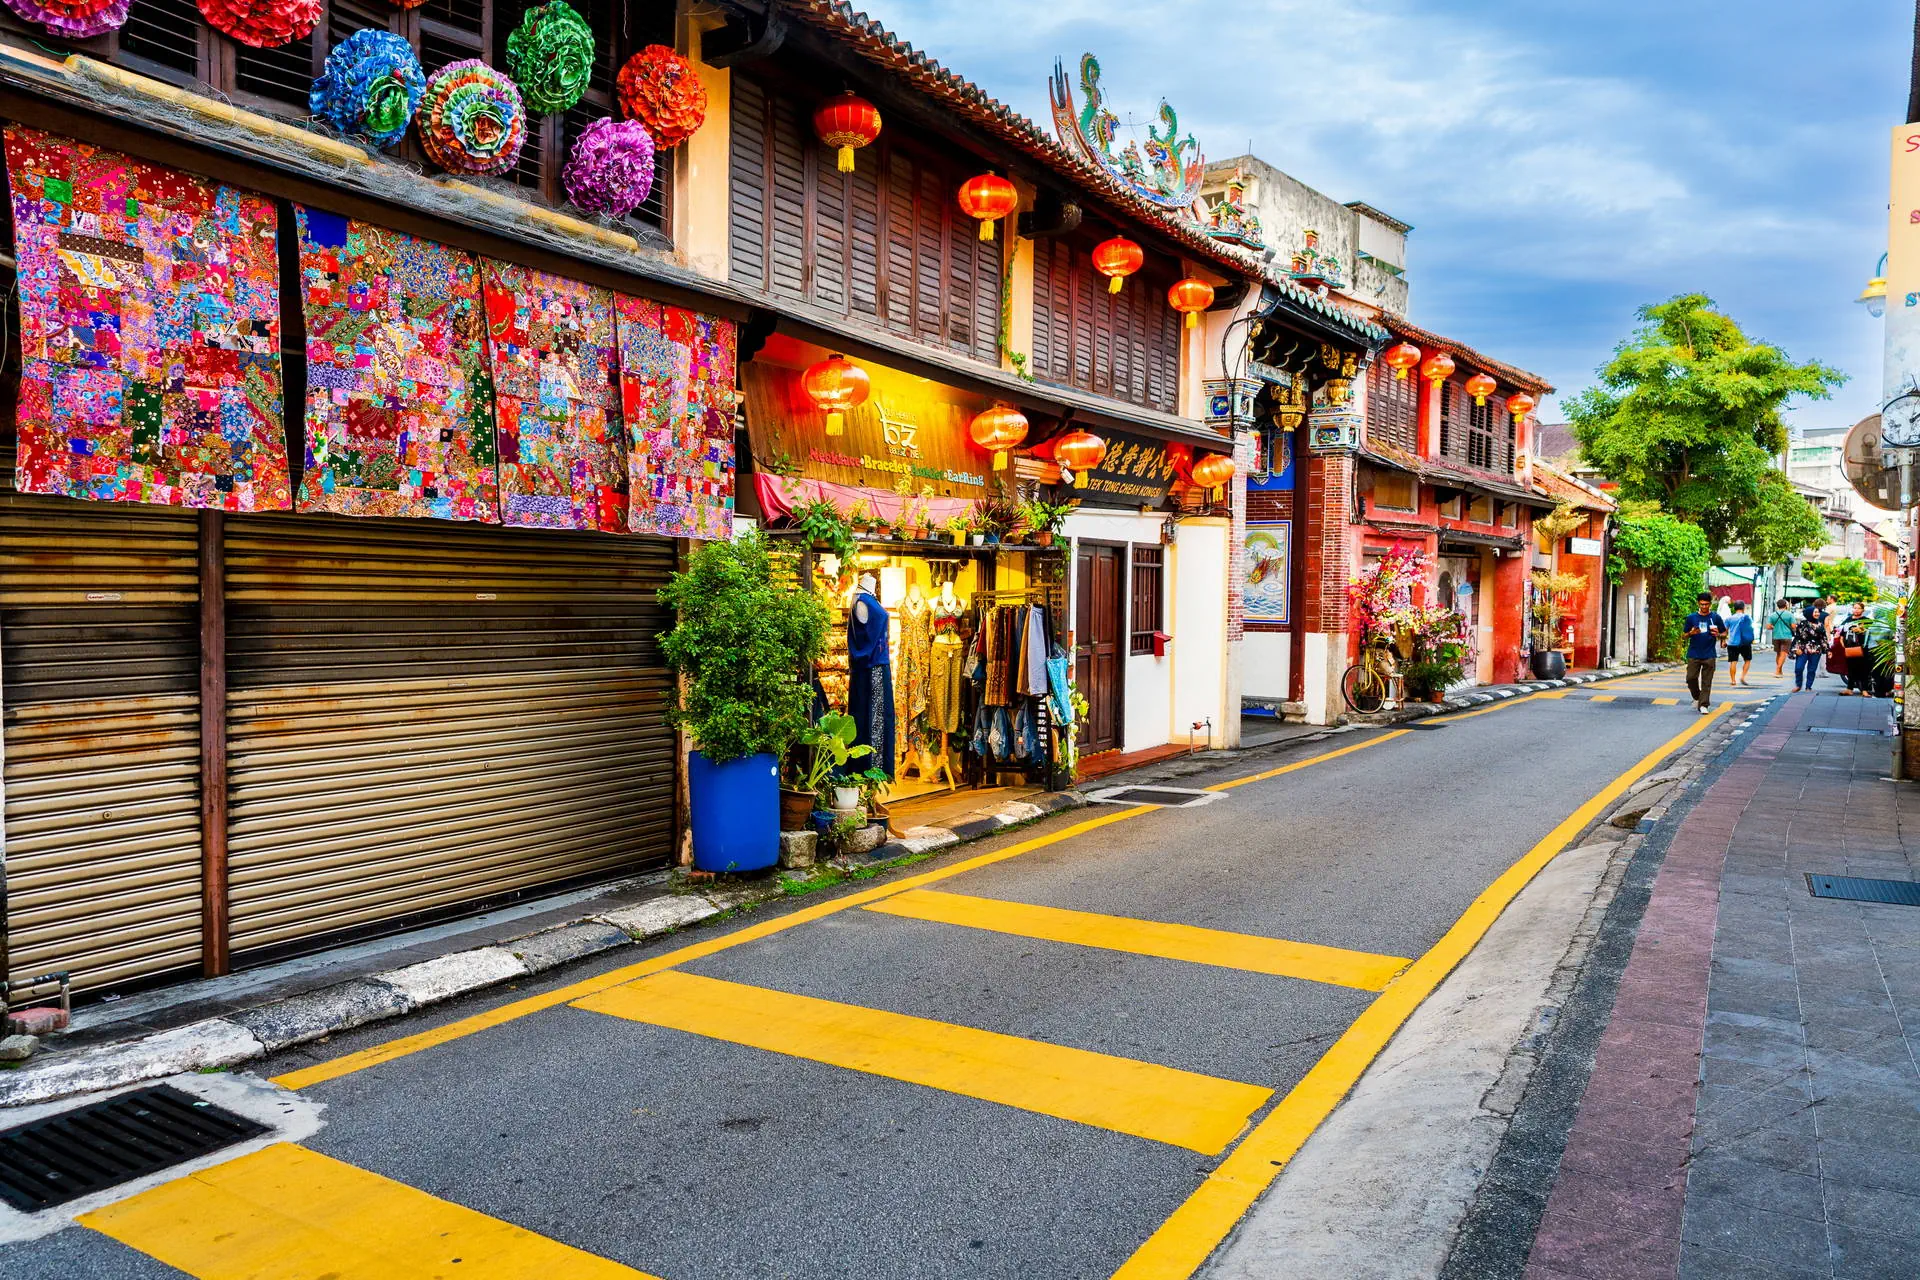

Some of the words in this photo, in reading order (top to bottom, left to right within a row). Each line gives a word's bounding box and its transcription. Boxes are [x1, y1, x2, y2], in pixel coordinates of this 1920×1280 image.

[809, 448, 860, 467] Necklace
[864, 454, 908, 475] Bracelet
[947, 469, 984, 487] EarRing
[1102, 437, 1181, 482] 德堂謝公司
[1087, 478, 1104, 491] TEK
[1102, 480, 1121, 493] TONG
[1118, 483, 1142, 496] CHEAH
